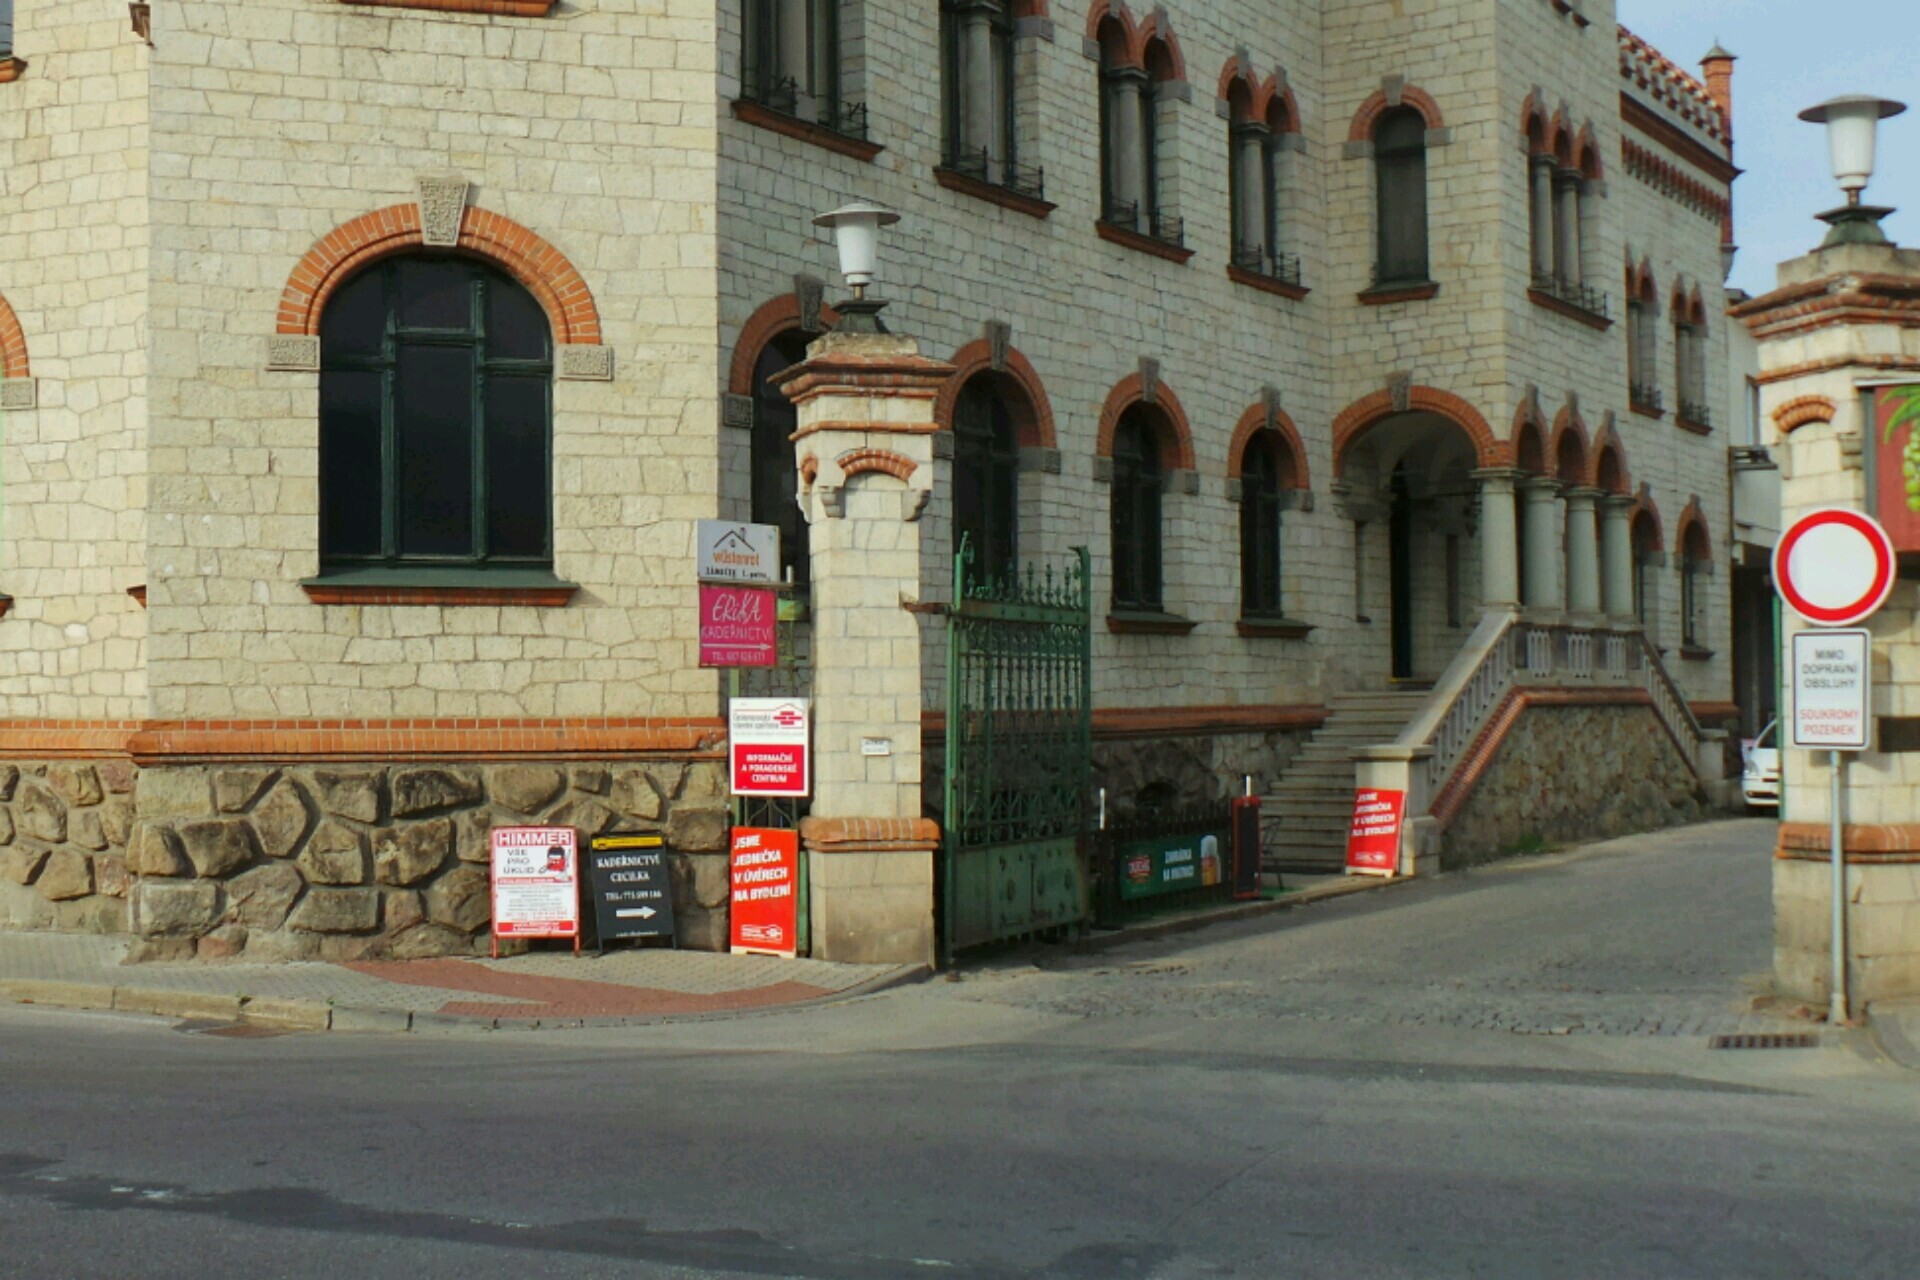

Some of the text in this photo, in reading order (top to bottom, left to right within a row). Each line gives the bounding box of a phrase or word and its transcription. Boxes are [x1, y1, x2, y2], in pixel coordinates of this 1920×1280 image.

[1804, 679, 1855, 688] OBSLUHY
[1803, 724, 1855, 735] POZEMEK
[752, 774, 787, 783] CENTRUM
[499, 832, 571, 846] HIMMER
[735, 835, 761, 849] JSME
[597, 853, 661, 868] KADEŘNICTVÍ
[735, 849, 782, 866] JEDNIČKA
[734, 881, 791, 901] NA BYDLENÍ
